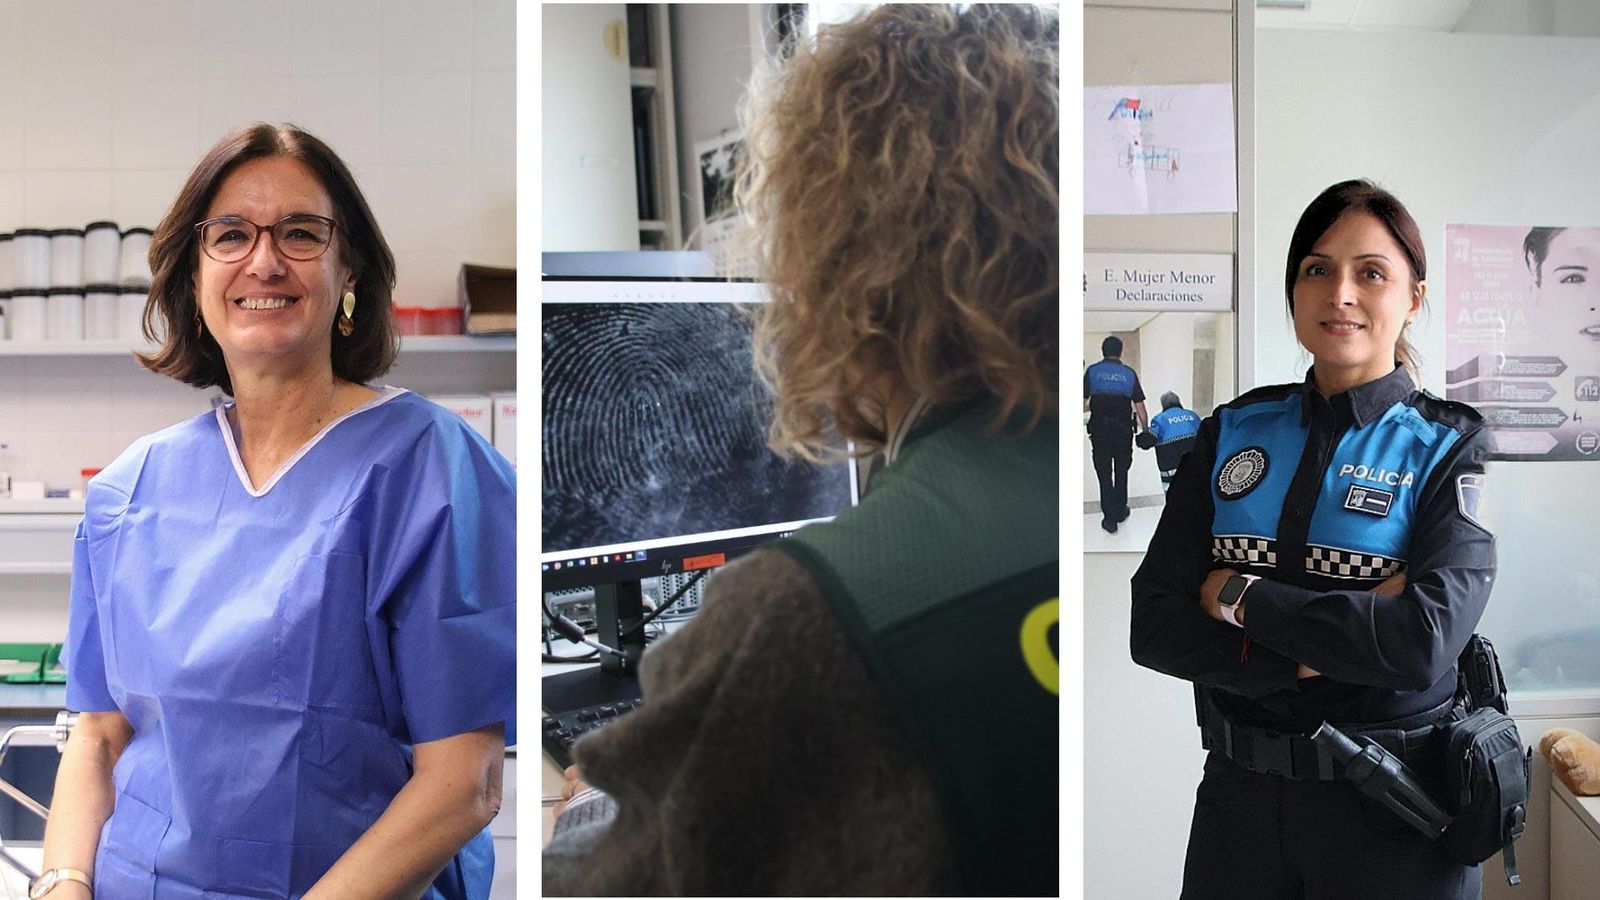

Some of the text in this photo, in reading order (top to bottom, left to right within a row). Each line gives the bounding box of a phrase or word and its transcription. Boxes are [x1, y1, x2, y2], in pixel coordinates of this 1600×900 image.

[1104, 269, 1216, 286] E. Mujer Menor
[1116, 289, 1204, 302] Declaraciones
[661, 559, 672, 574] hp
